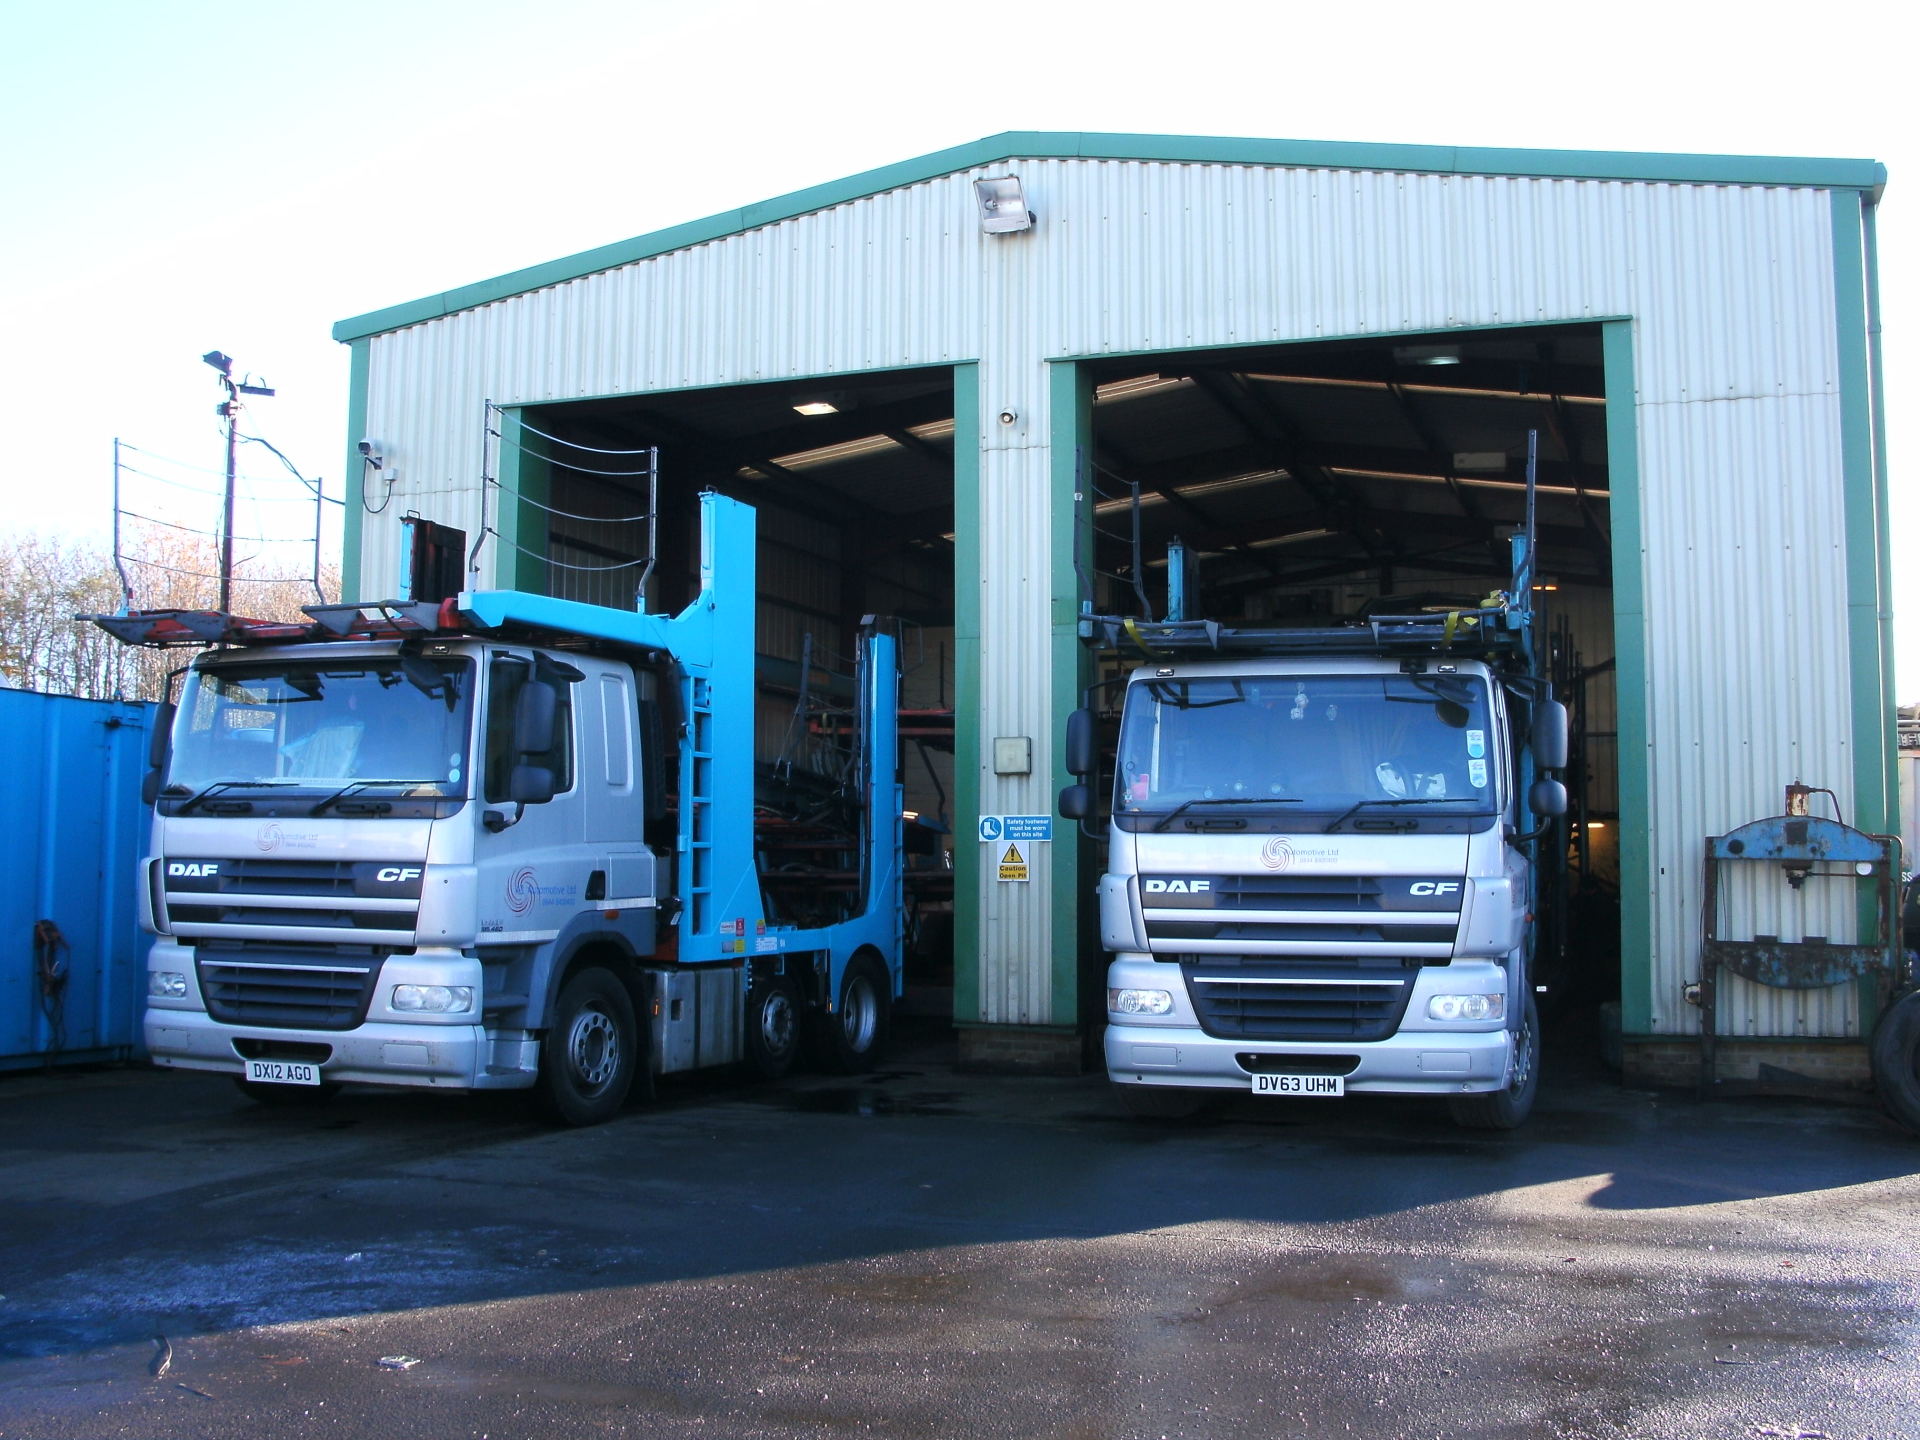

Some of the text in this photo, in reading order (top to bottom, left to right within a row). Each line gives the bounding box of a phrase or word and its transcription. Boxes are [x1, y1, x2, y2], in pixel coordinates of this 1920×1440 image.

[1327, 848, 1339, 856] Ltd
[168, 863, 219, 877] DAF
[376, 867, 422, 882] CF
[1145, 879, 1210, 893] DAF
[1409, 881, 1459, 896] CF
[253, 1063, 312, 1081] DX12 AGO
[1258, 1076, 1337, 1093] DV63 UHM
